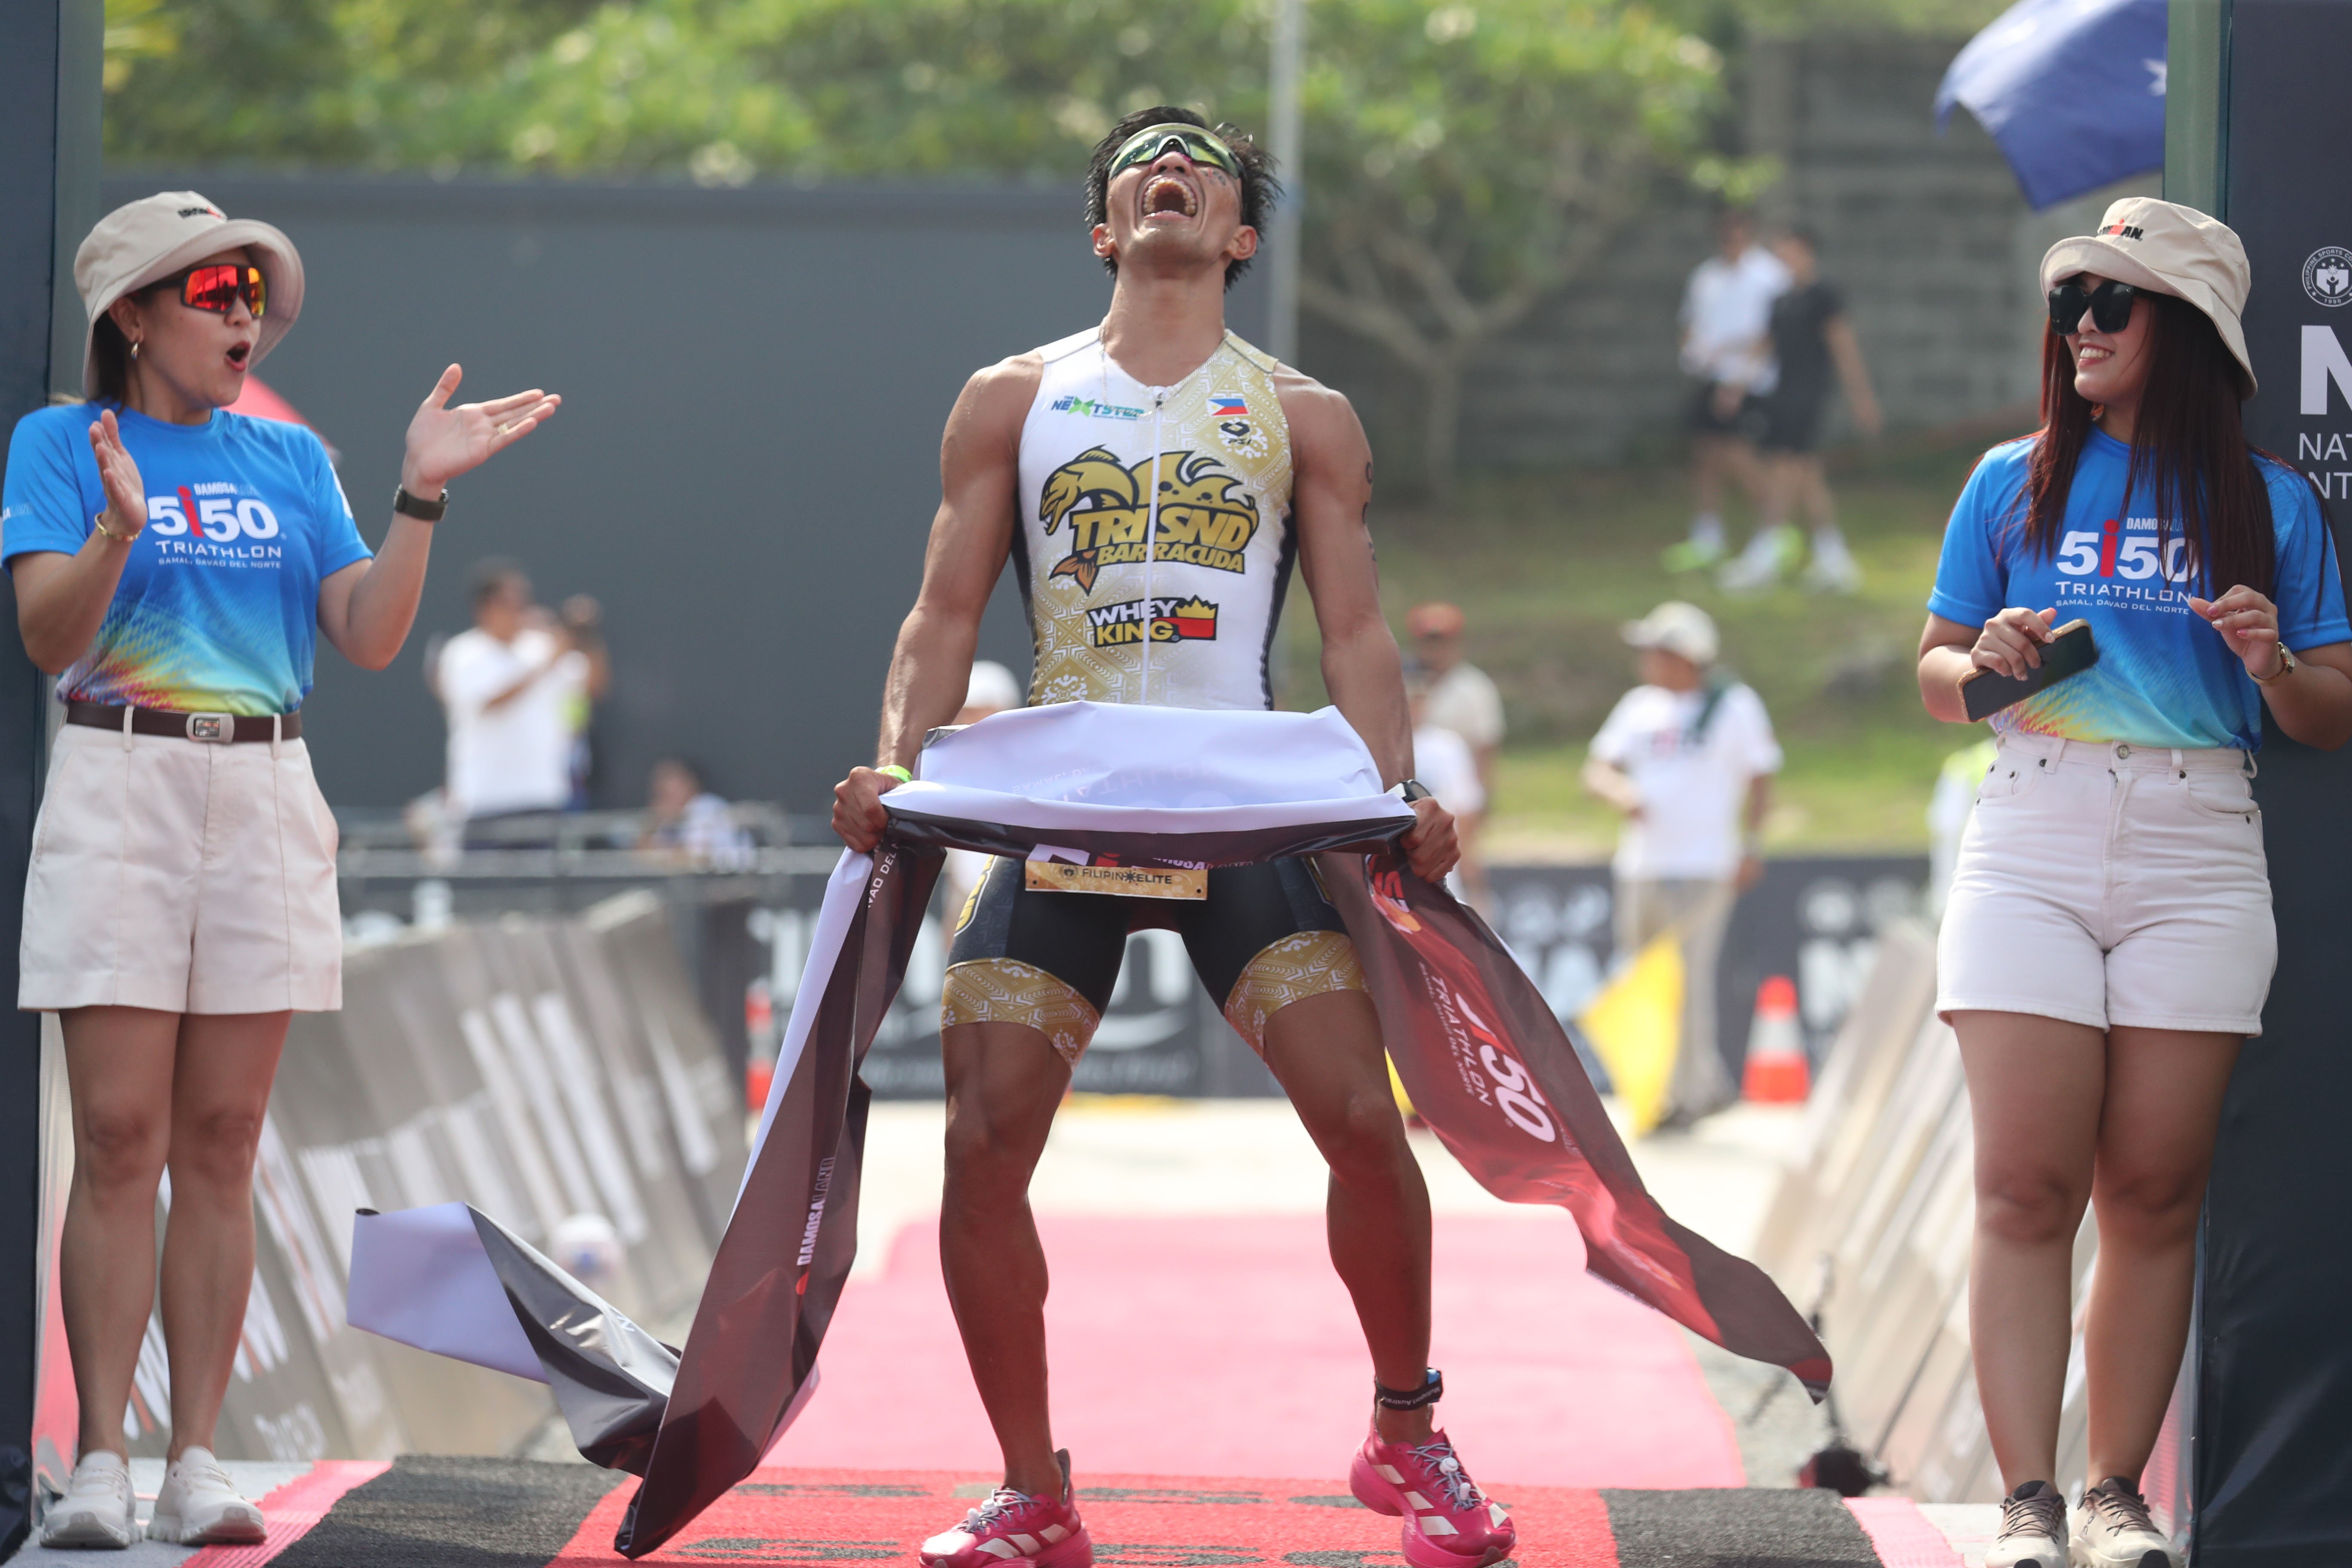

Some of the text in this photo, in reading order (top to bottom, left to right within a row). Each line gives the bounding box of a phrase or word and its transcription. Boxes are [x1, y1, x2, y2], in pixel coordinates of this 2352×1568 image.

[2305, 257, 2318, 290] PHILIPPINE
[2318, 249, 2343, 257] SPORTS
[2299, 433, 2352, 461] NA
[1073, 506, 1251, 552] TRI SND
[155, 540, 282, 558] TRIATHLON
[1096, 542, 1244, 573] BARRACUDA
[196, 558, 226, 567] DAVAO
[230, 560, 248, 568] DEL
[251, 560, 282, 569] NORTE
[2055, 581, 2192, 603] TRIATHLON
[1090, 600, 1179, 626] WHEY
[2056, 599, 2093, 607] SAMAL,
[2098, 599, 2128, 609] DAVAO
[2156, 605, 2189, 615] NORTE
[1096, 620, 1174, 645] KING
[880, 853, 897, 874] DEL
[1137, 874, 1172, 884] ELITE
[1431, 975, 1493, 1107] TRIATHLON
